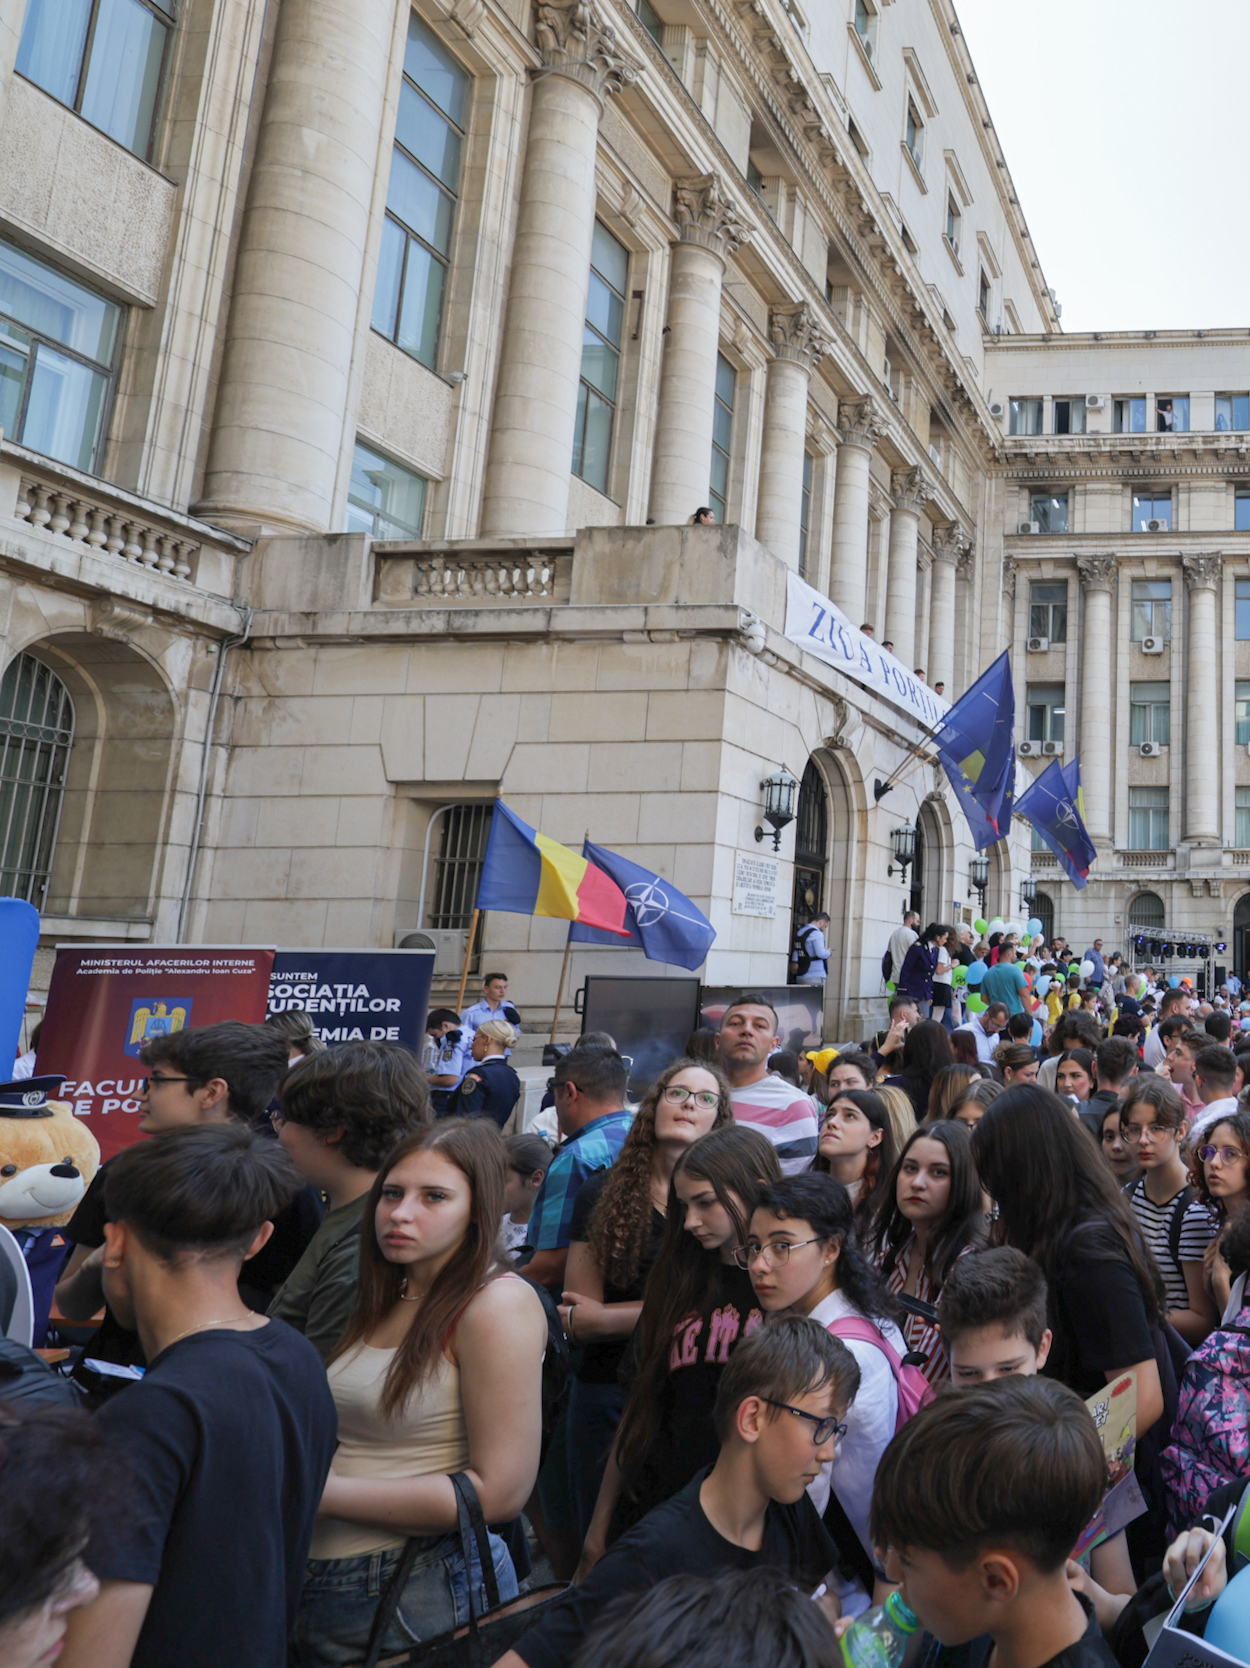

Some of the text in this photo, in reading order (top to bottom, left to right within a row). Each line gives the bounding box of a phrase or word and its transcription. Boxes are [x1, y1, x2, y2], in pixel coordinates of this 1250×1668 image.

[807, 601, 874, 675] ZIUA
[80, 959, 255, 967] MINISTERUL AFACERILOR INTERNE
[135, 968, 163, 976] Poliție
[270, 972, 318, 980] SUNTEM
[267, 998, 402, 1017] UDENȚILOR
[369, 1026, 400, 1041] DE
[60, 1099, 93, 1115] E
